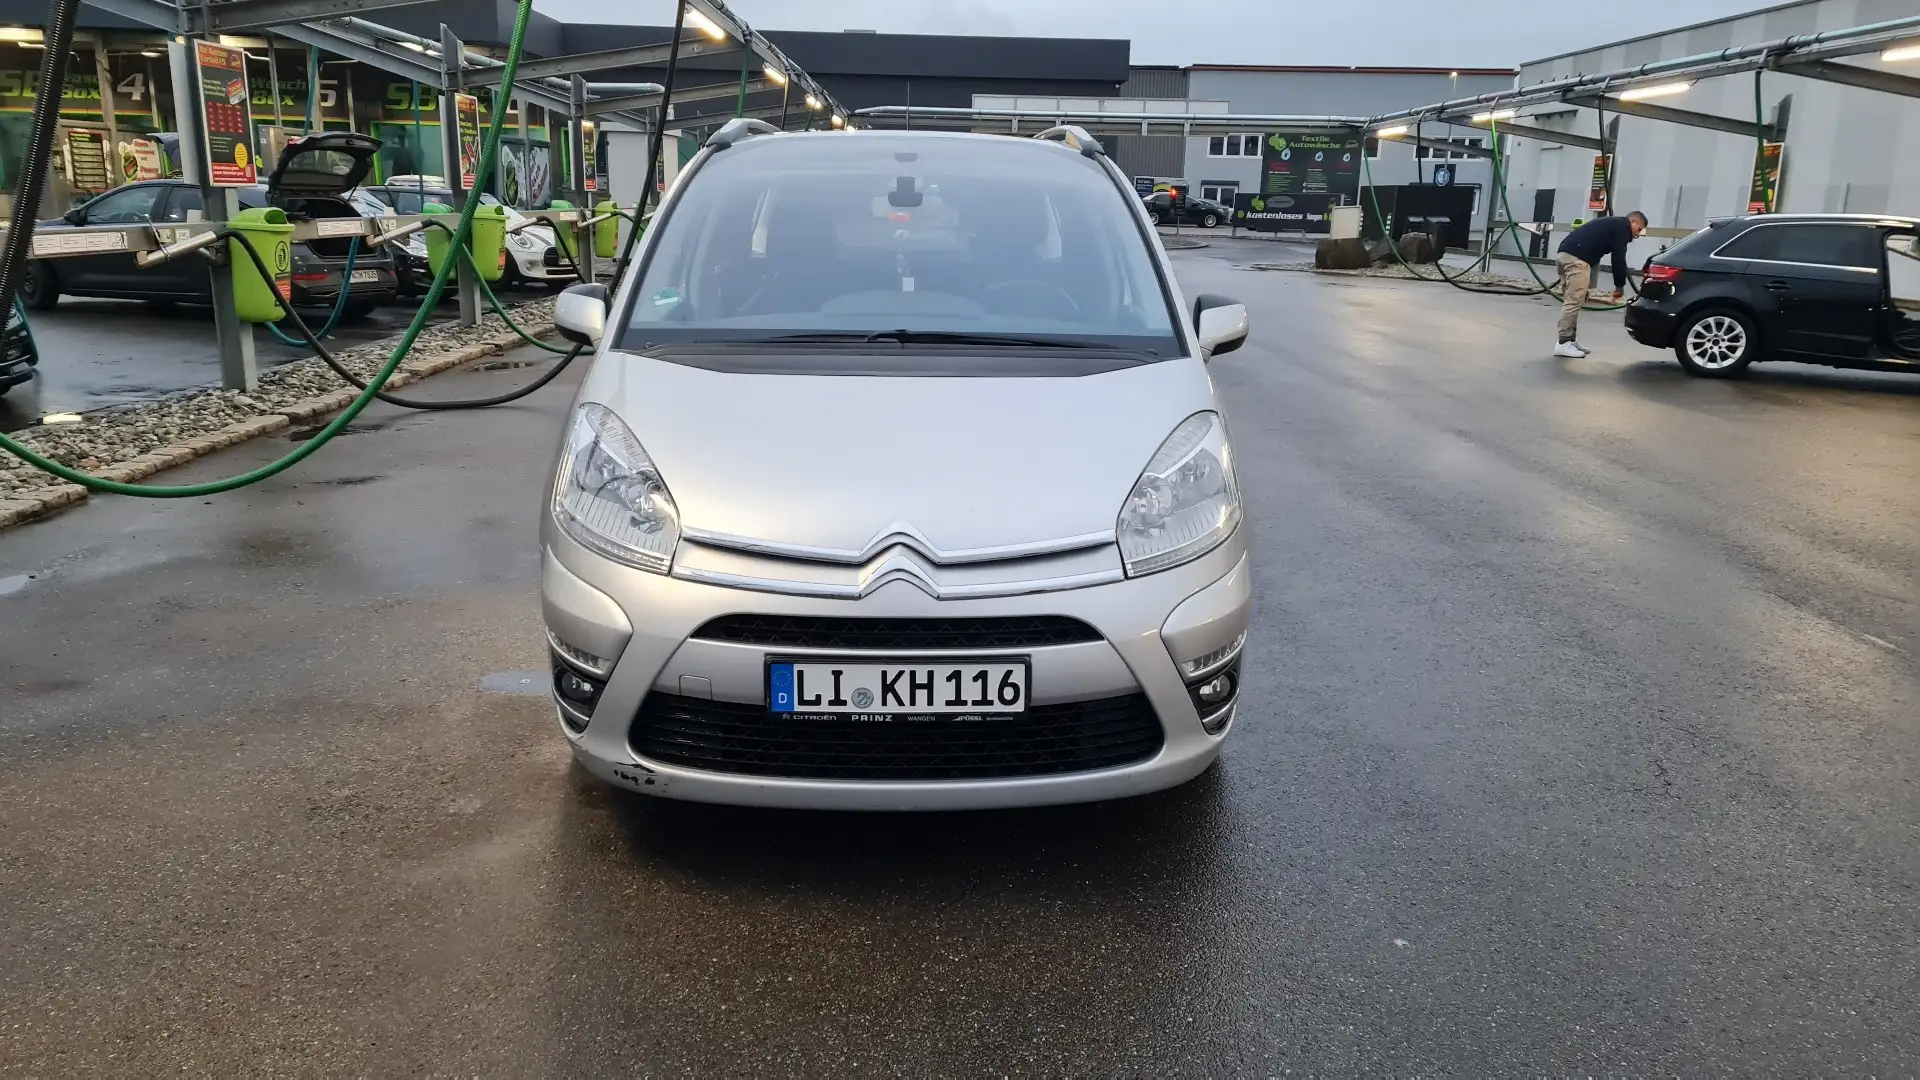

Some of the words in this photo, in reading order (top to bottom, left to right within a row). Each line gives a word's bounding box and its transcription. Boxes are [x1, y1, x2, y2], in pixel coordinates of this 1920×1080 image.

[117, 73, 145, 100] 4
[1288, 141, 1341, 149] Autowäsche
[1246, 211, 1303, 220] kostenloses
[796, 669, 848, 707] LI
[778, 692, 788, 704] D
[851, 714, 893, 722] PRINZ
